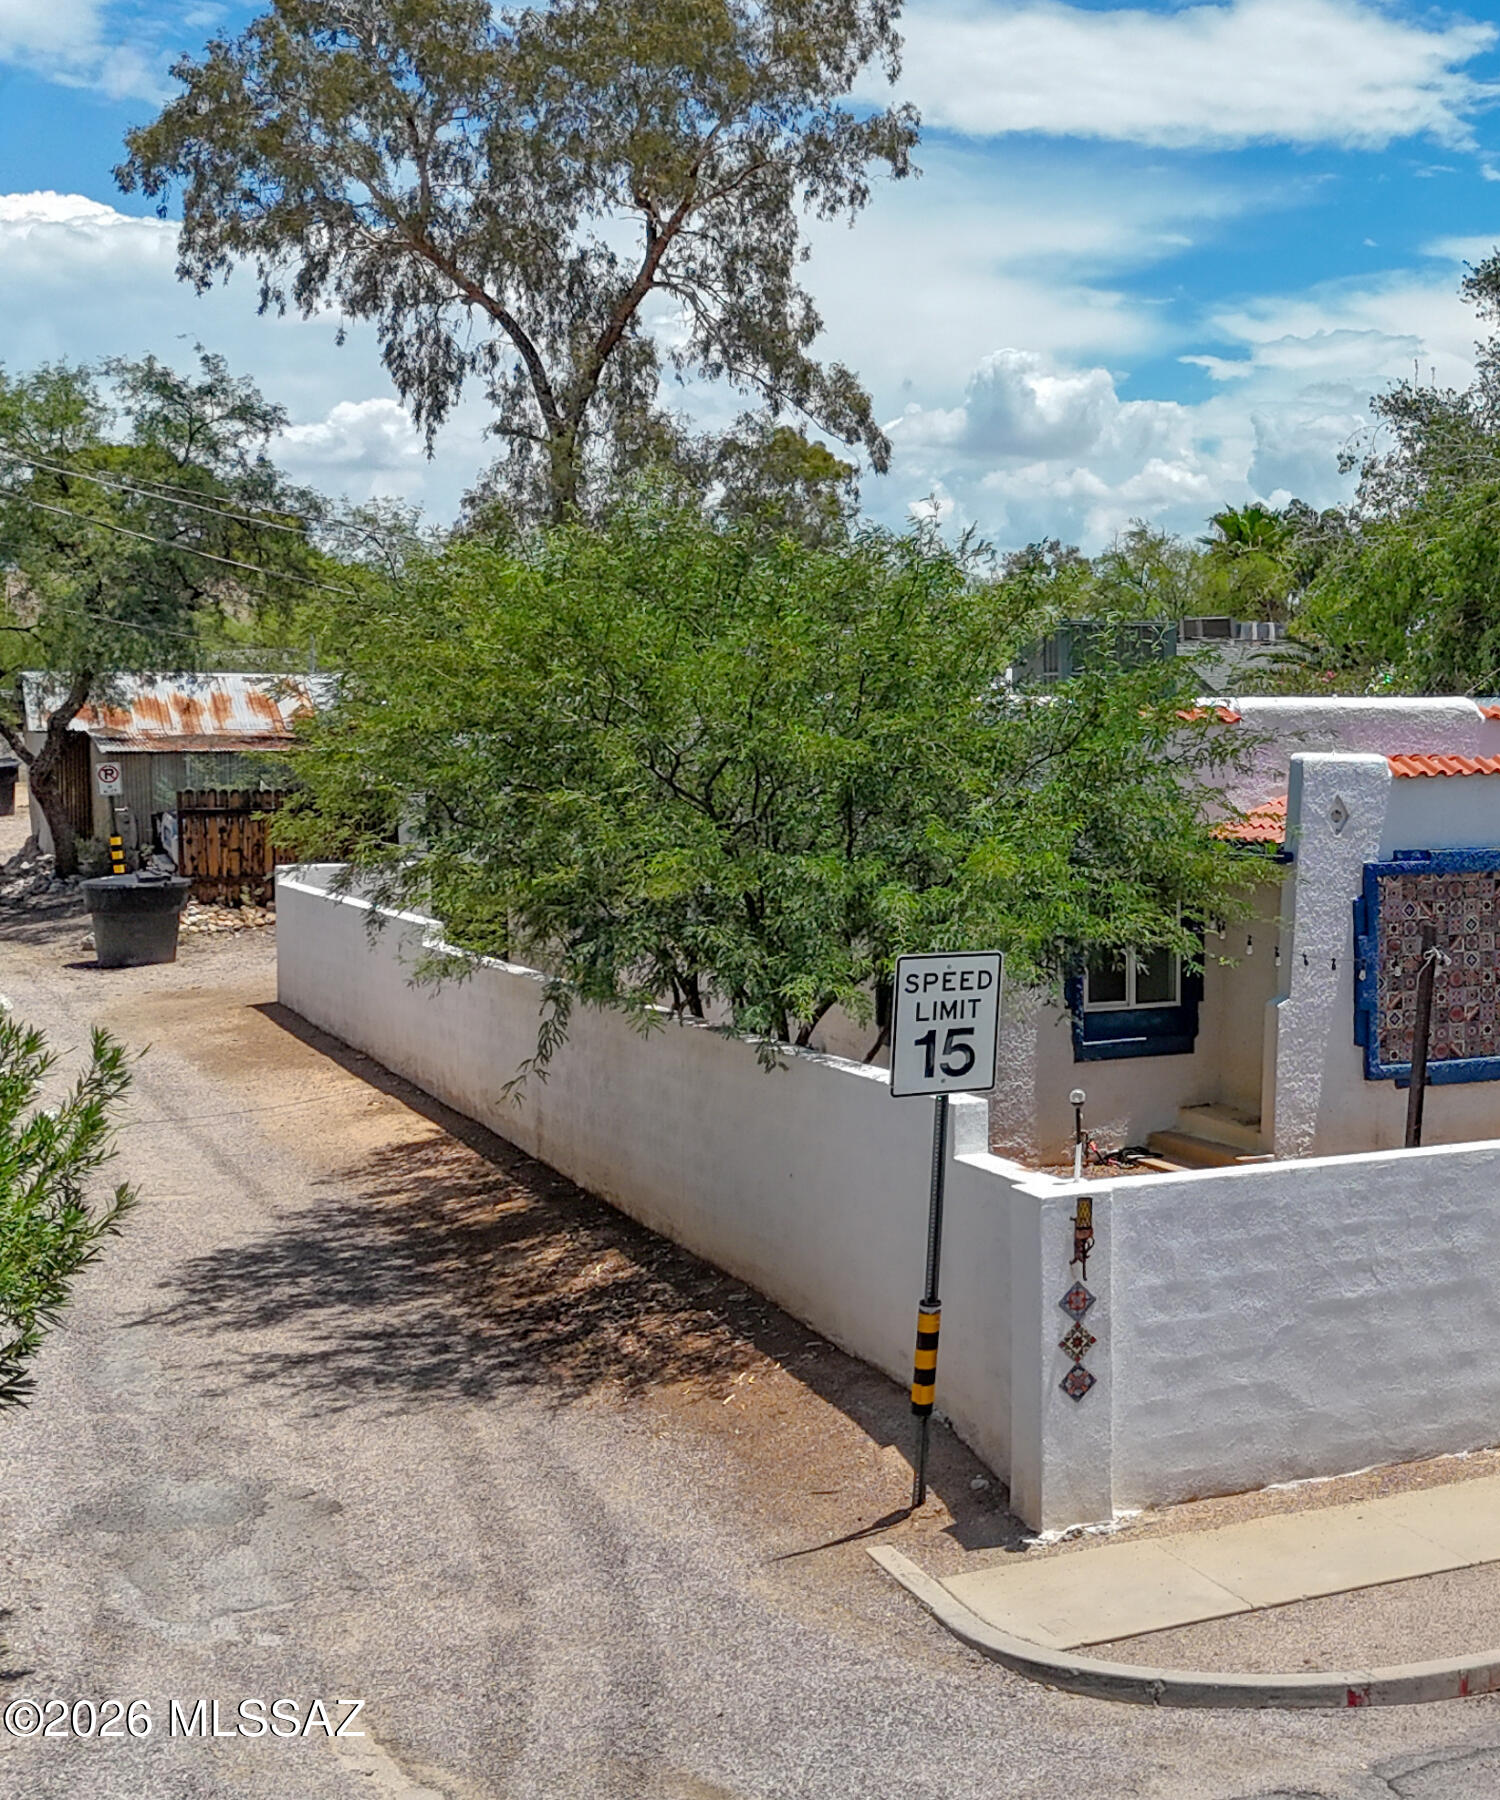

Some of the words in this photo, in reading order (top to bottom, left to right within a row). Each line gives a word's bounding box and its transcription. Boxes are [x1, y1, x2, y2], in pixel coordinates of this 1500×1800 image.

[904, 969, 993, 994] SPEED
[915, 998, 982, 1022] LIMIT
[914, 1027, 976, 1078] 15
